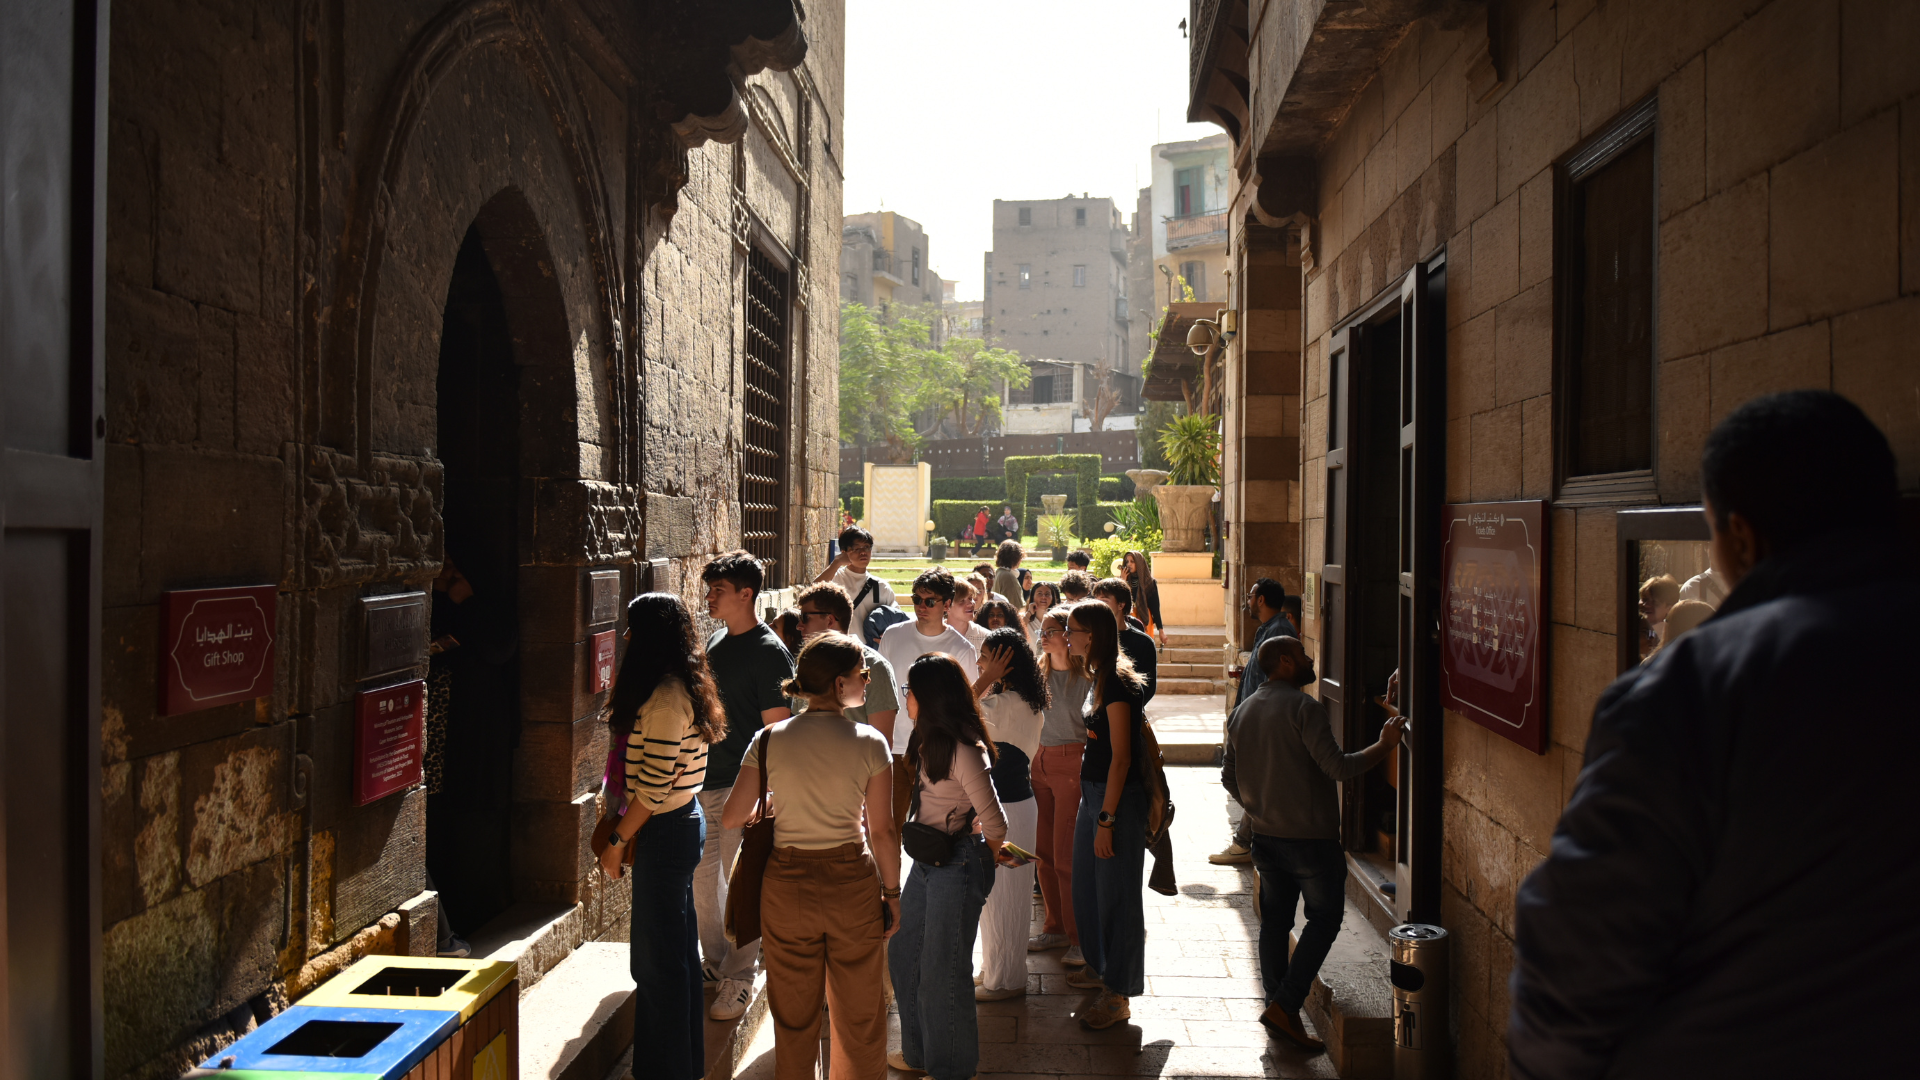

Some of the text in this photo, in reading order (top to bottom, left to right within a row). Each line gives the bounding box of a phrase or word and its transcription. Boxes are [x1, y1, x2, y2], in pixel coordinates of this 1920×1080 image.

[1486, 526, 1496, 535] Office
[196, 623, 252, 647] بيت الهدايا
[204, 650, 244, 667] Gift Shop
